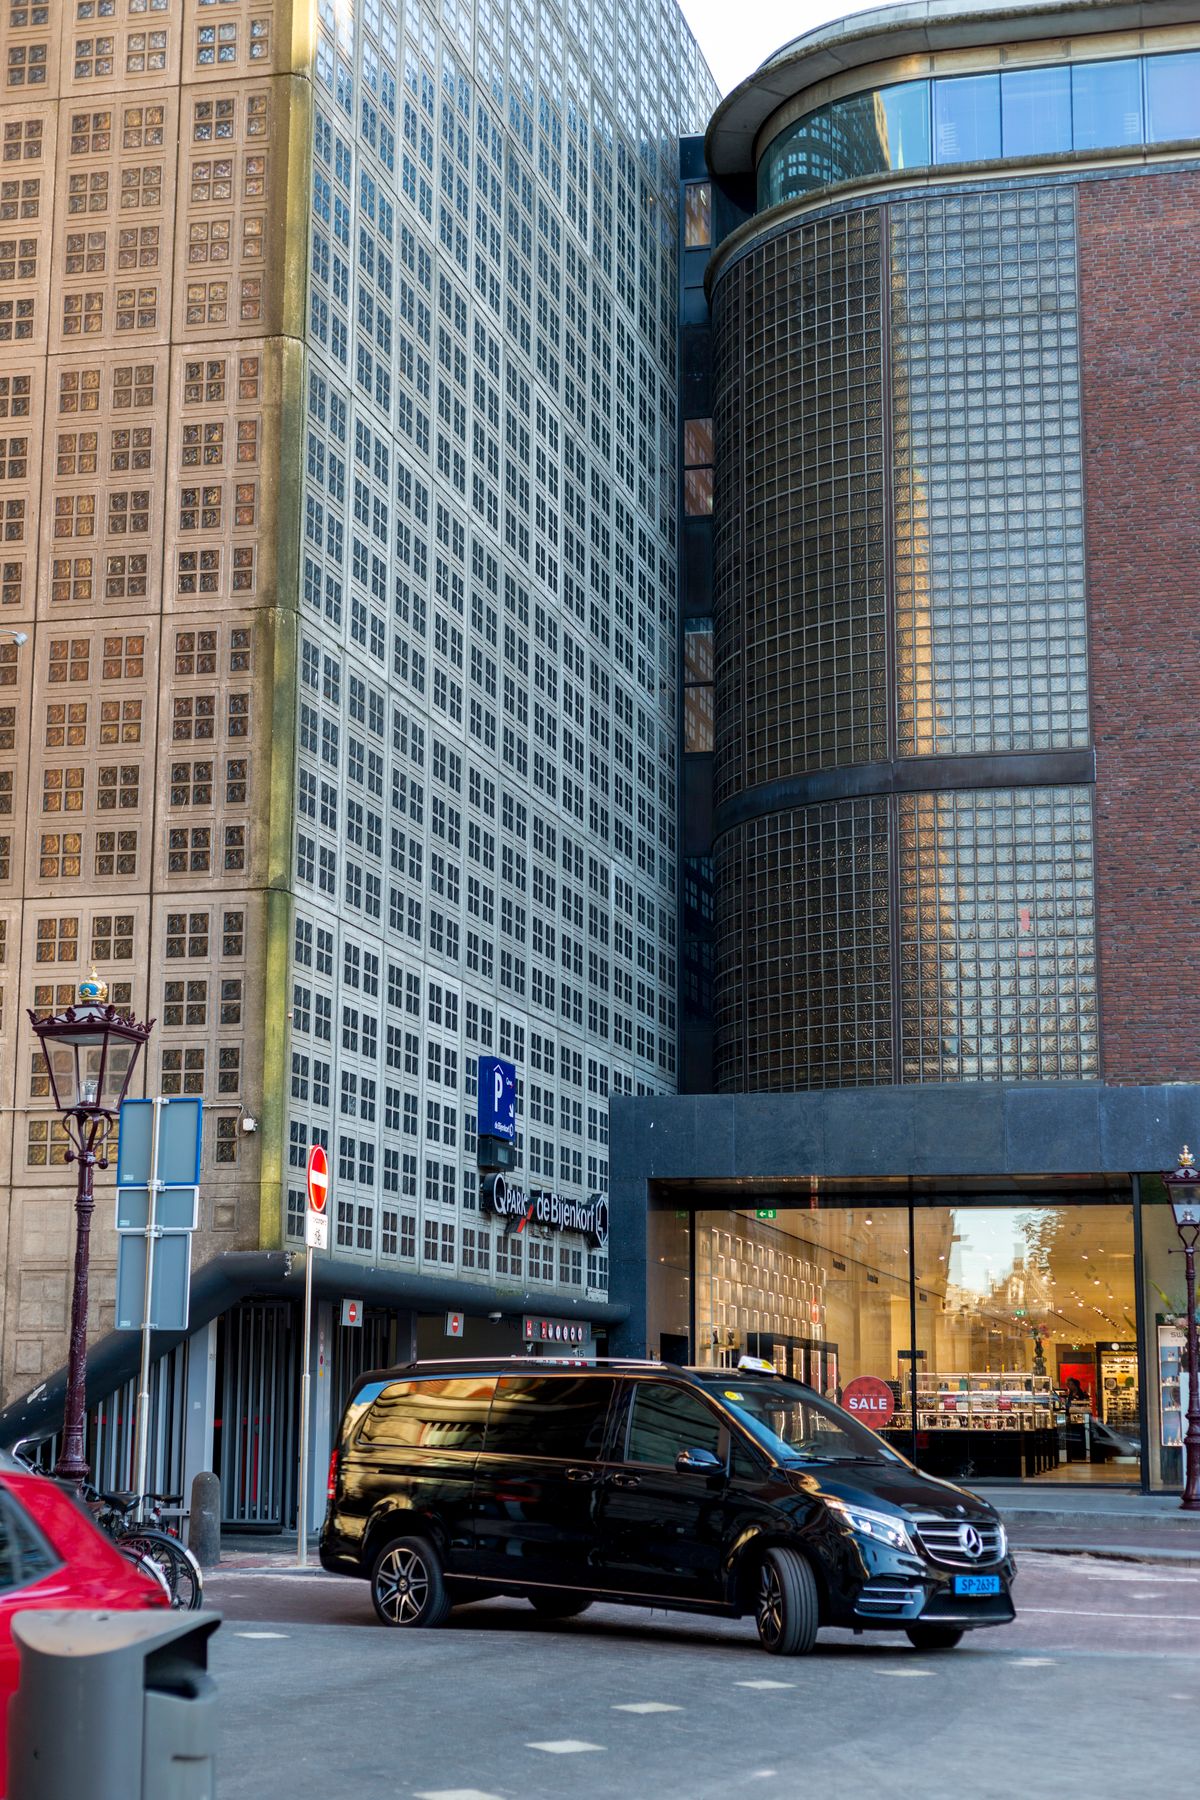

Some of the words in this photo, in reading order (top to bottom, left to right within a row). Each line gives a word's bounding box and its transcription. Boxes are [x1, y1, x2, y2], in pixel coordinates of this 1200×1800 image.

[495, 1072, 503, 1112] P
[537, 1191, 550, 1221] de
[551, 1194, 594, 1232] Bijenkorf
[849, 1397, 887, 1410] SALE
